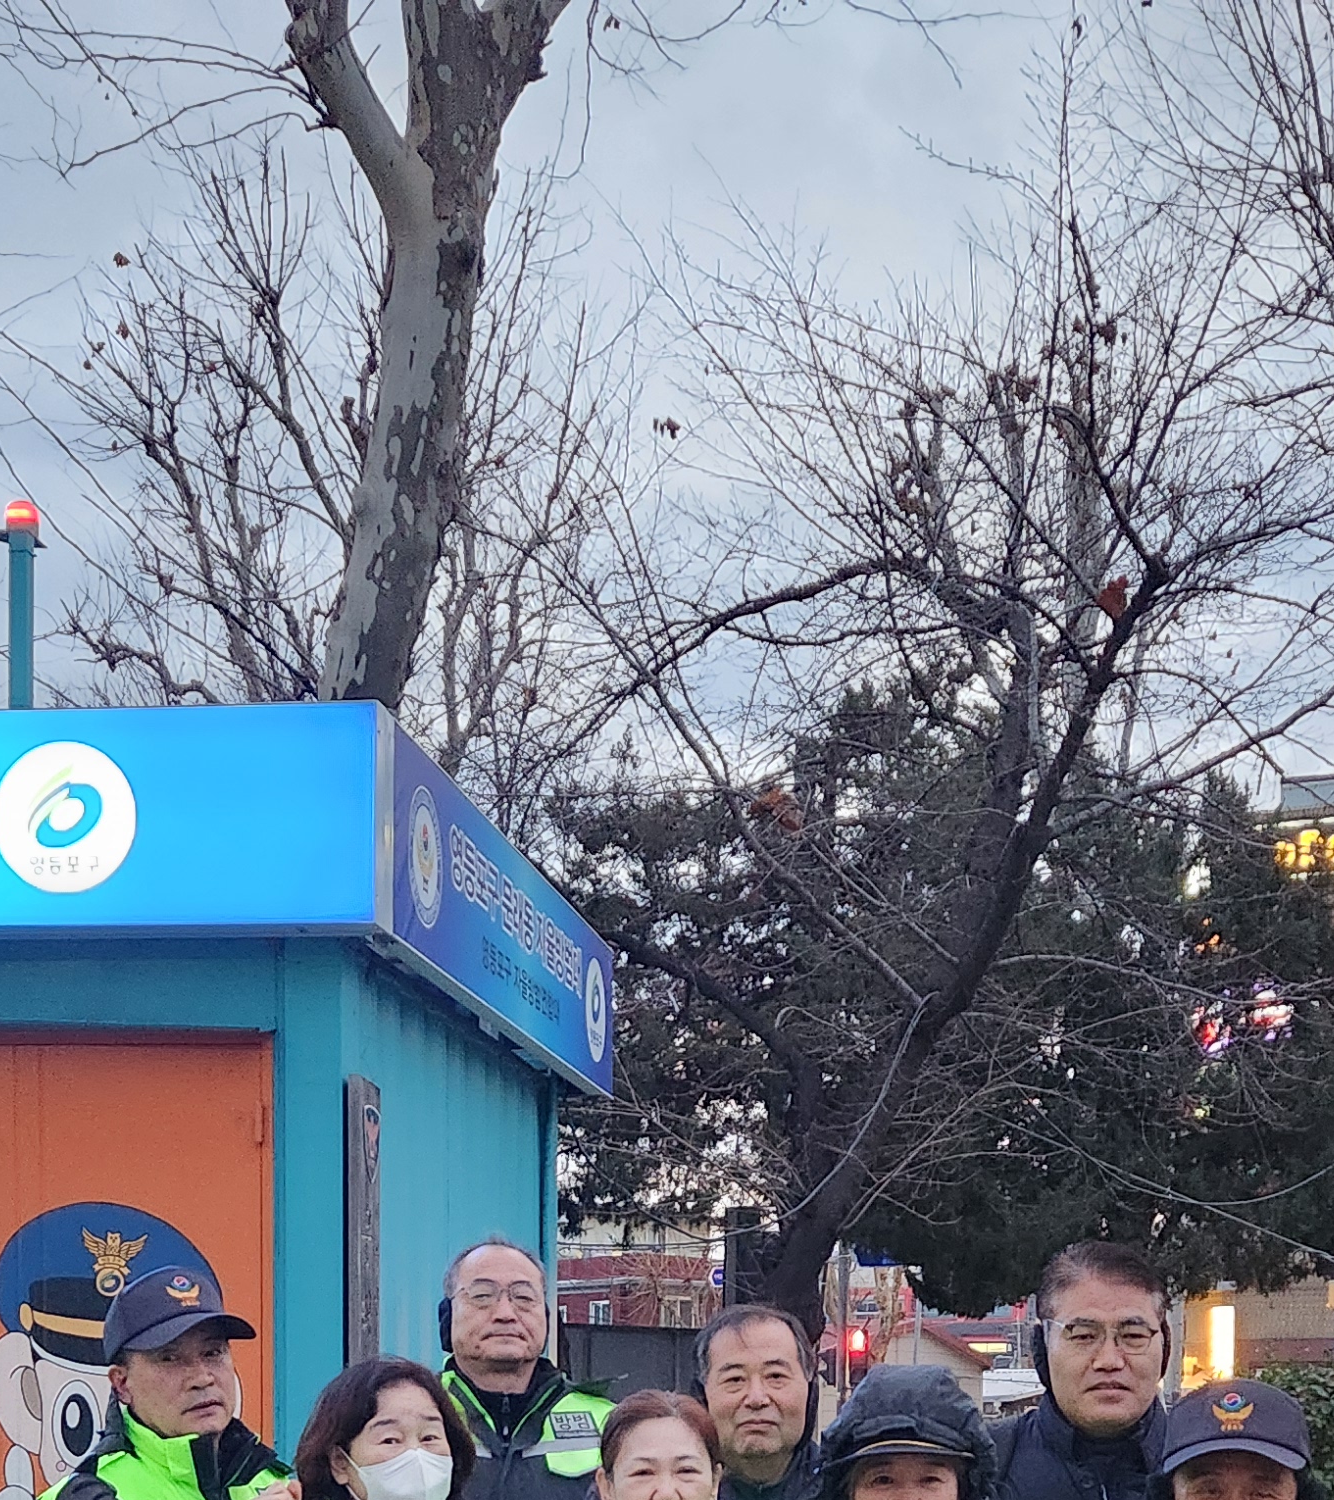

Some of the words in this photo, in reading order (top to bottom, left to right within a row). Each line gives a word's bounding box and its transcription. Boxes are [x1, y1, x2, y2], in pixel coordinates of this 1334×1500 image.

[449, 823, 500, 922] 영등포구
[500, 873, 536, 956] 문래동
[554, 1413, 591, 1430] 방범
